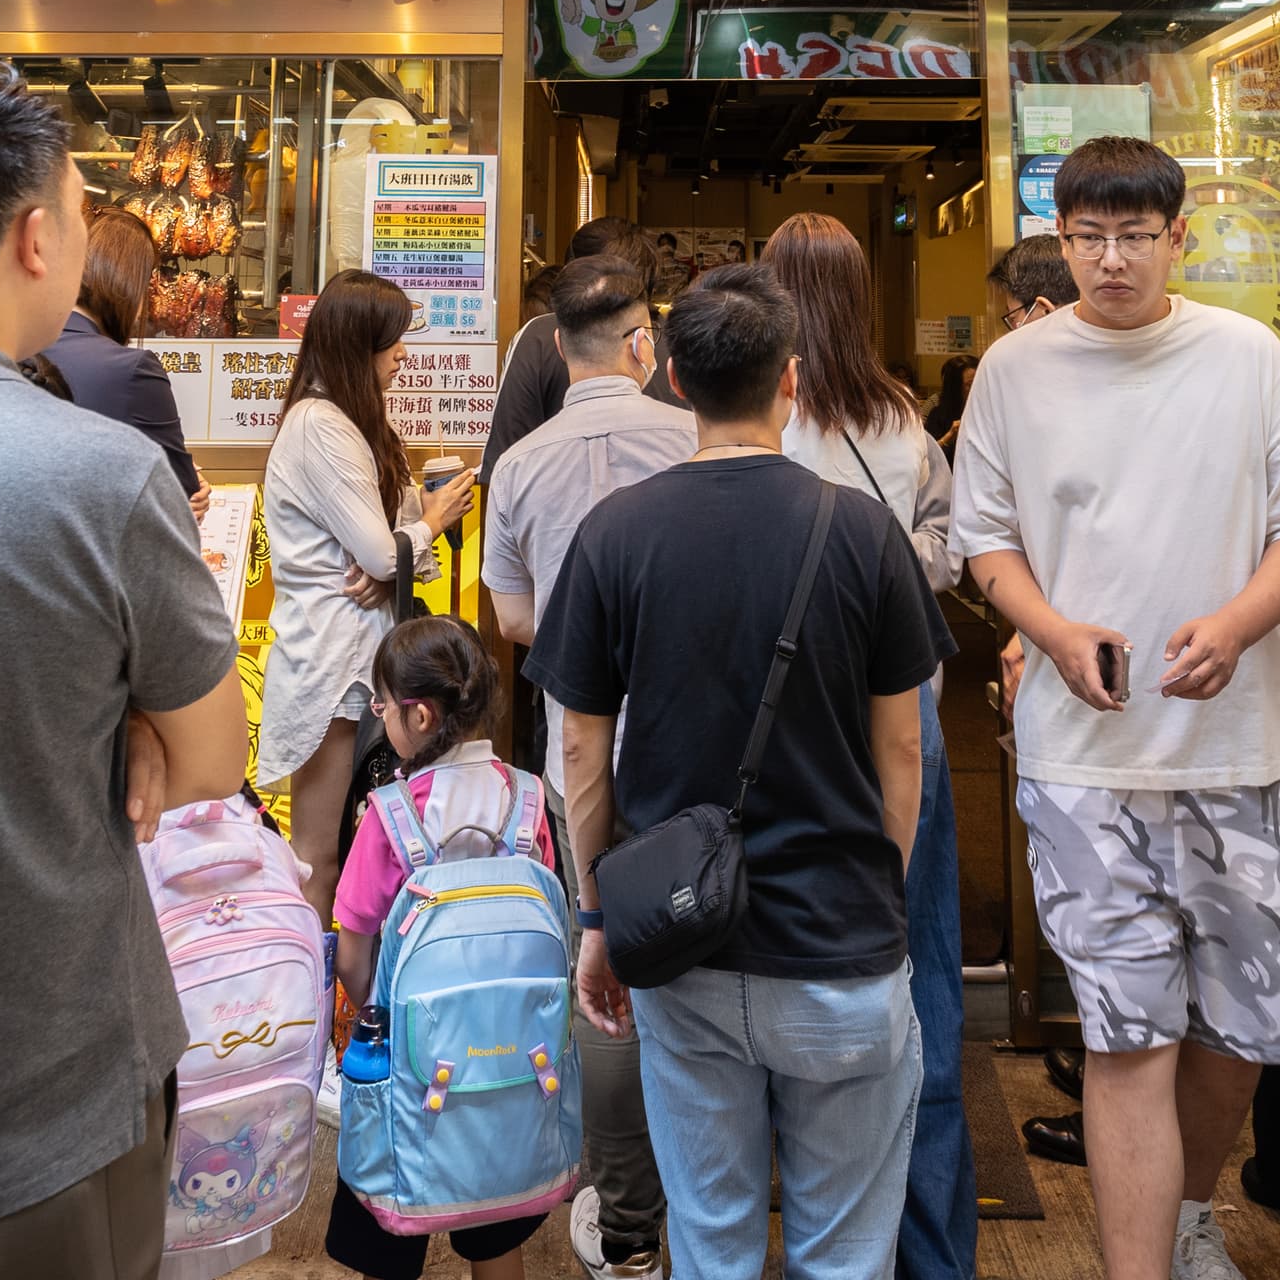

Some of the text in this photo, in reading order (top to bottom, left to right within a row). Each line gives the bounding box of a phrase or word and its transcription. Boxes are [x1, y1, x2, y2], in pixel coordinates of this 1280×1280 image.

[389, 173, 473, 186] 大班日日有湯飲
[462, 298, 481, 310] $12
[462, 314, 475, 326] $6
[156, 352, 202, 373] 燒皇
[393, 374, 433, 389] $150
